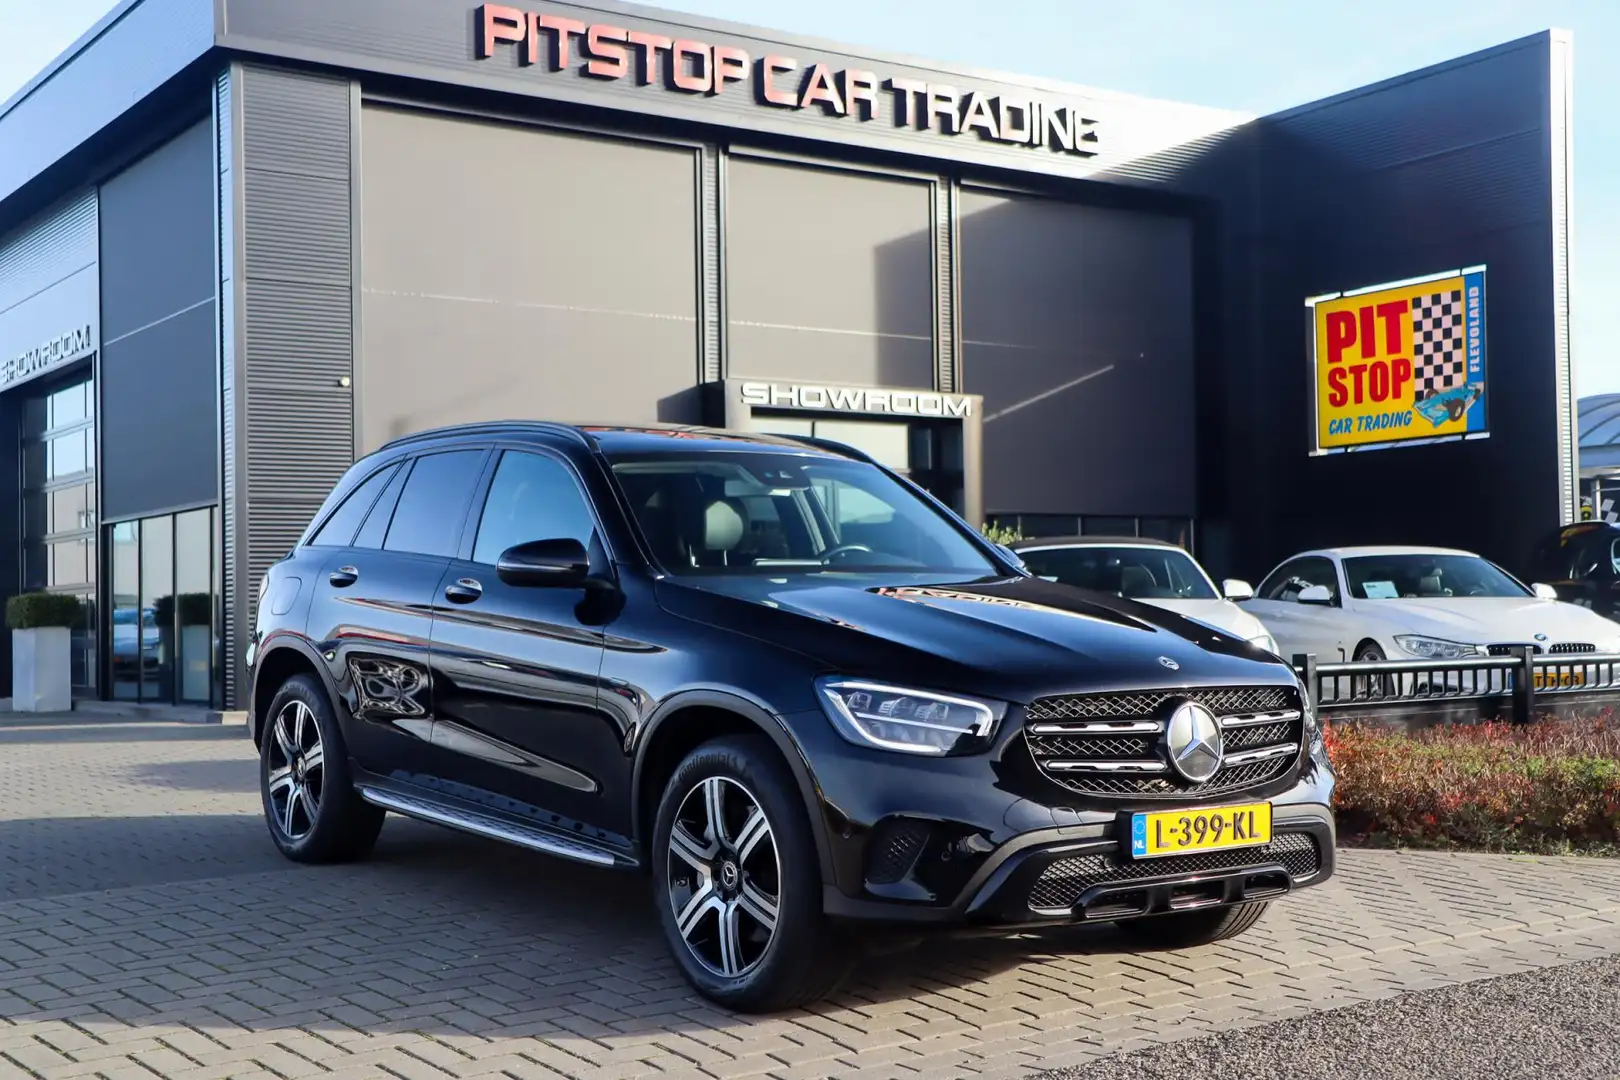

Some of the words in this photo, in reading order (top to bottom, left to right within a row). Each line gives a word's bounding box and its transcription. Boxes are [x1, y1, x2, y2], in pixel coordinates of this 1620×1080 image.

[476, 3, 750, 96] PITSTOP
[754, 54, 879, 121] CAR
[1326, 300, 1409, 364] PIT
[1469, 286, 1480, 373] FLEVOLAND
[741, 382, 972, 417] SHOWROOM
[1328, 358, 1411, 408] STOP
[1329, 418, 1352, 435] CAR
[1357, 411, 1413, 432] TRADING
[1134, 840, 1145, 849] NL
[1156, 811, 1260, 849] L-399-KL
